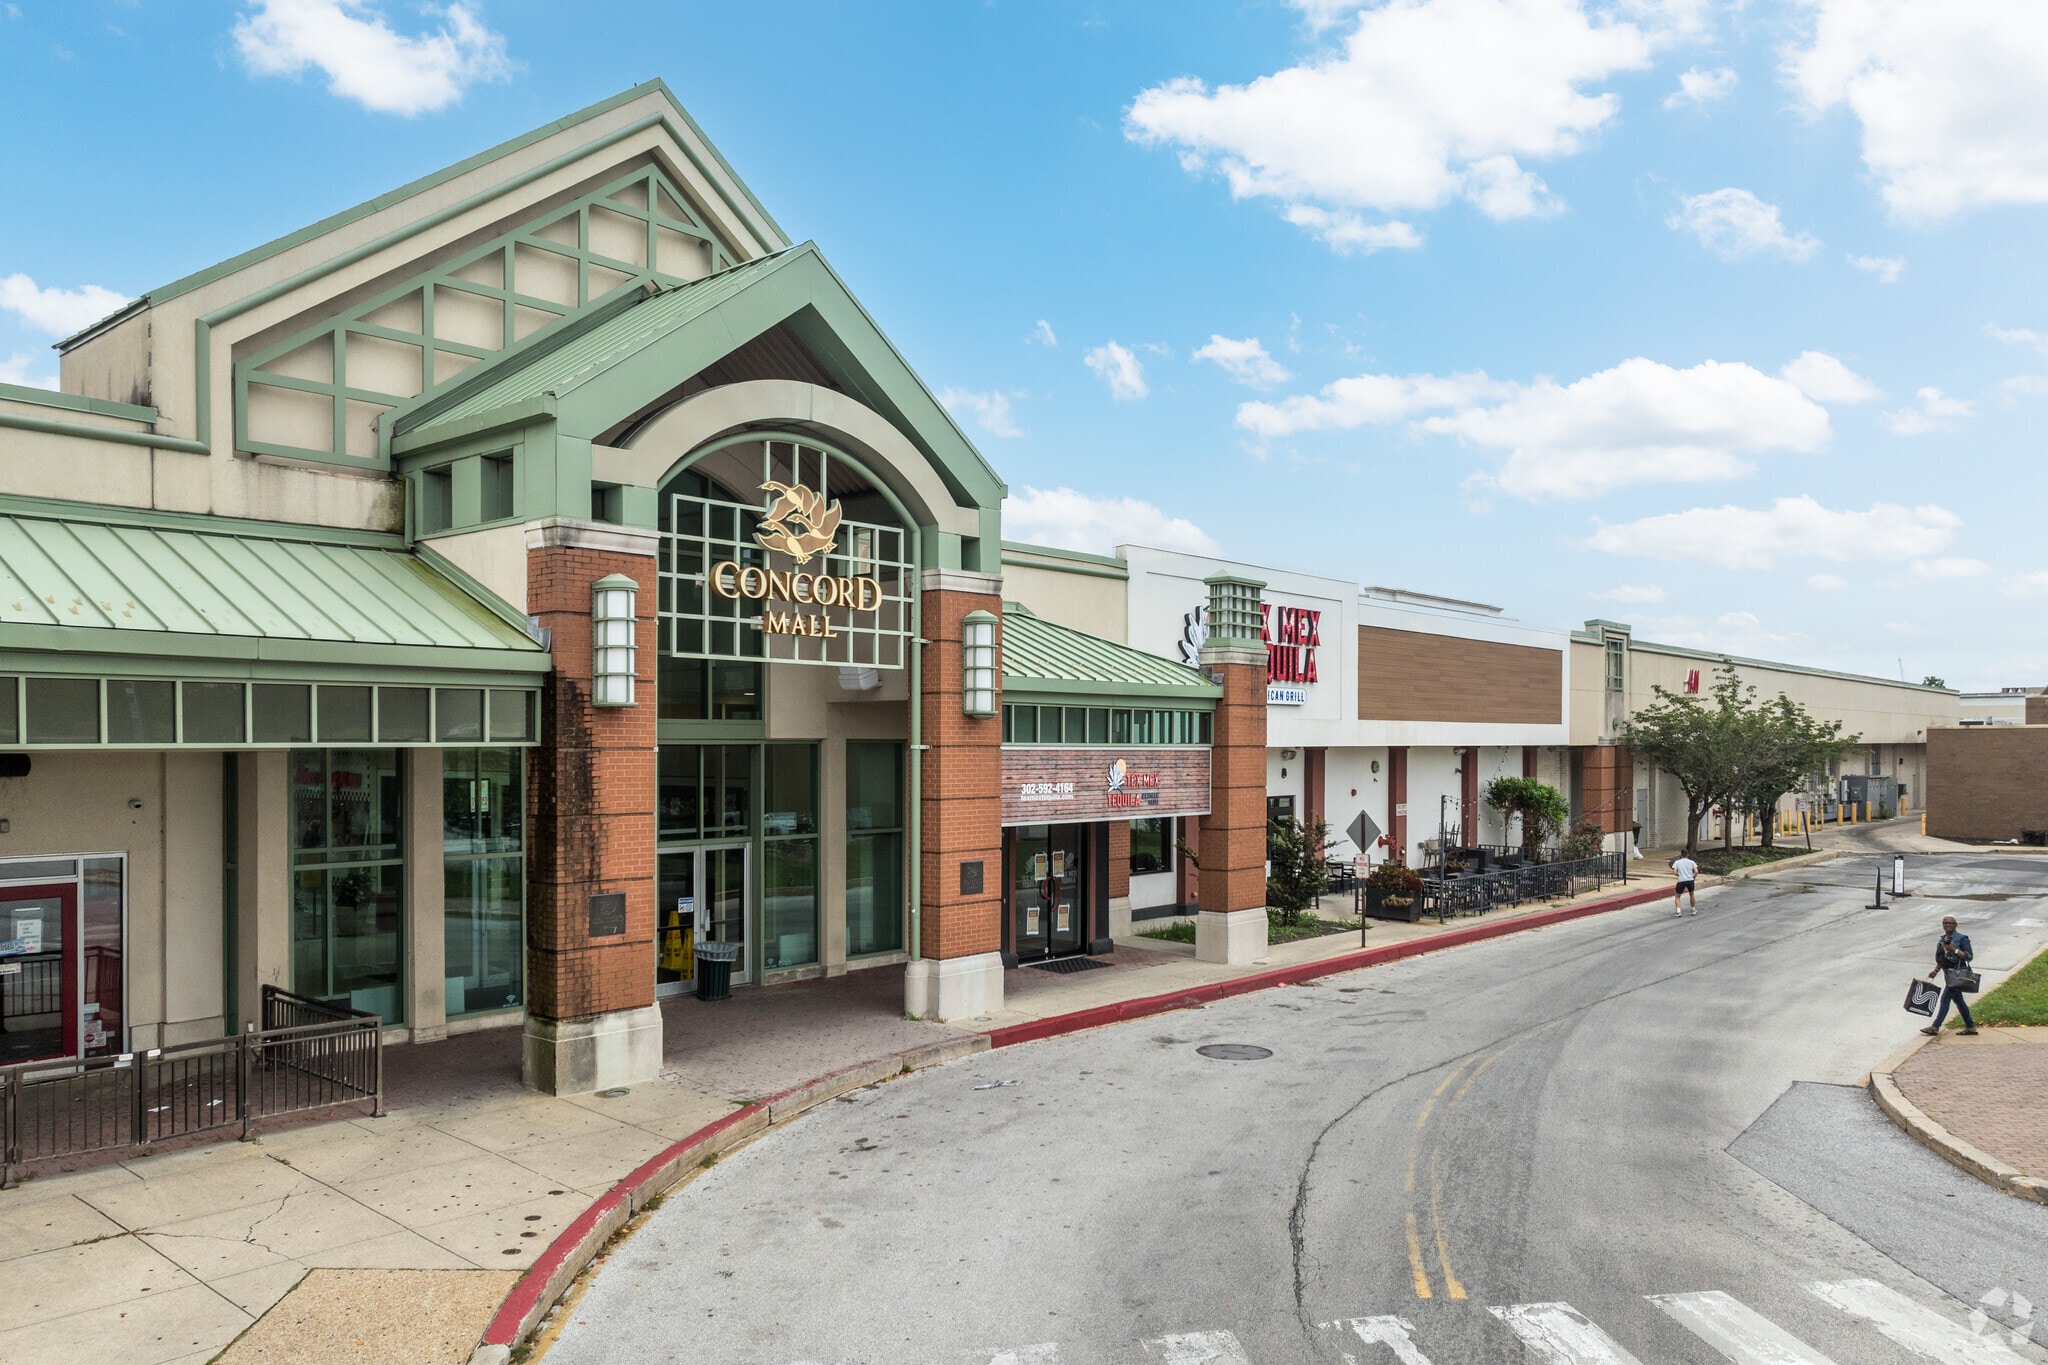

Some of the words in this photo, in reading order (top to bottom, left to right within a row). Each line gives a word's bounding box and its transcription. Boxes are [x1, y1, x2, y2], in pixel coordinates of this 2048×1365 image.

[710, 561, 882, 611] CONCORD
[763, 611, 837, 638] MALL
[1278, 606, 1321, 646] MEX
[1264, 643, 1318, 684] QUILA
[1267, 690, 1284, 701] ICAN
[1285, 691, 1305, 702] GRILL
[1021, 782, 1074, 795] 302-592-4164
[1126, 774, 1141, 787] TEX
[1143, 774, 1160, 787] MEX
[1107, 793, 1141, 808] TEQUILA
